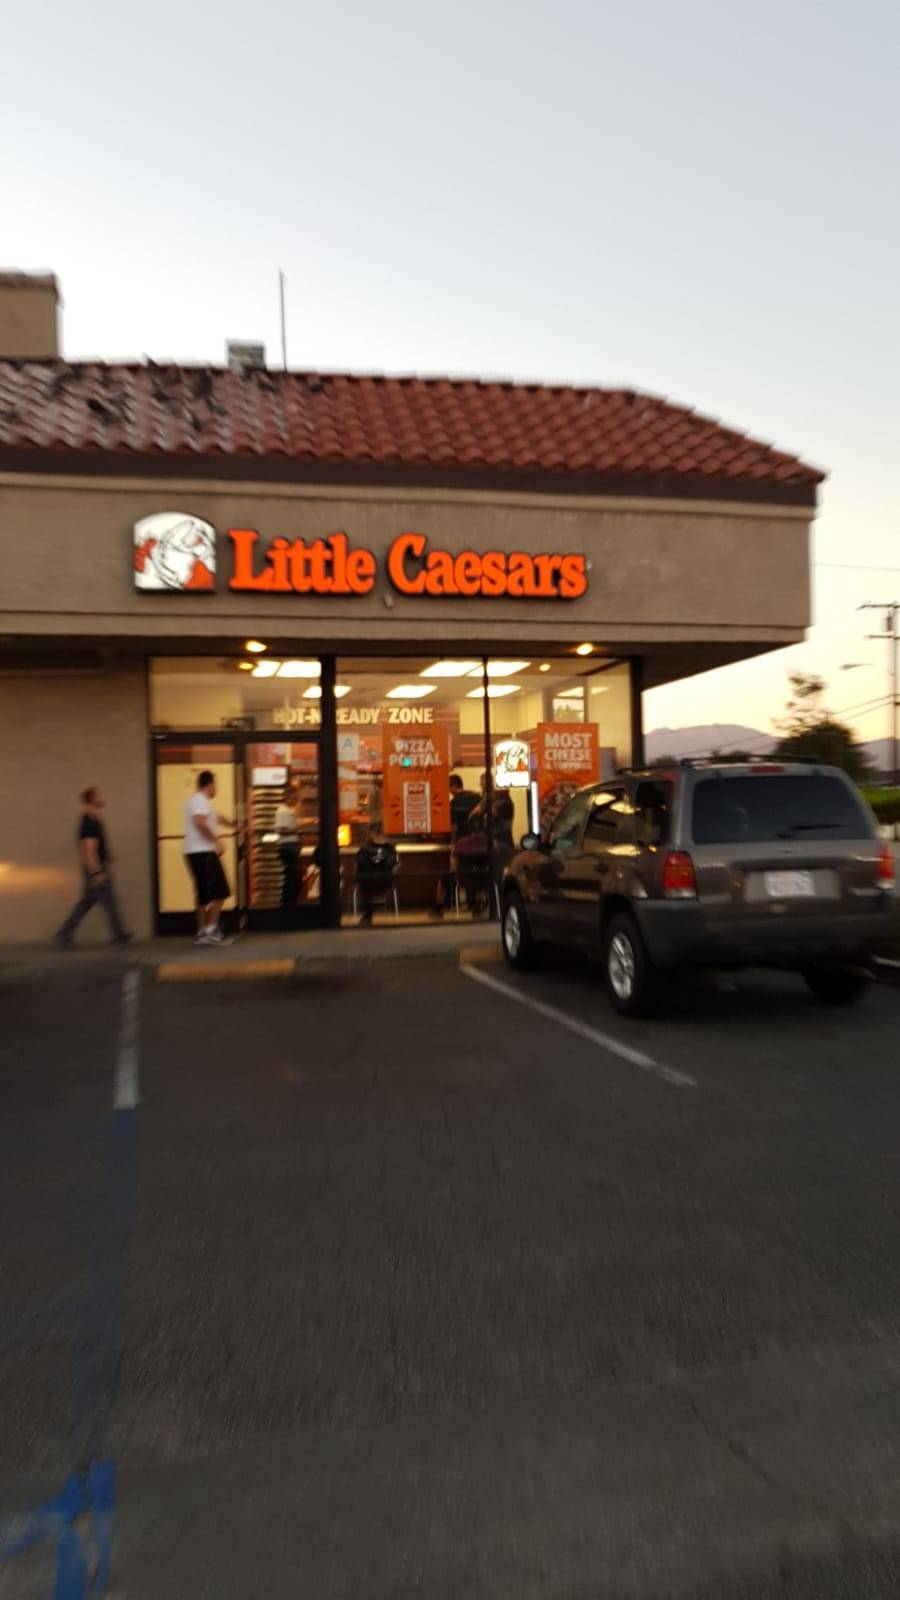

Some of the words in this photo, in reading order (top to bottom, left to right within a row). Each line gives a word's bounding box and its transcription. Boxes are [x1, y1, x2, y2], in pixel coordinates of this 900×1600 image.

[228, 528, 376, 594] Little
[388, 532, 589, 598] Caesars
[388, 707, 434, 724] ZONE
[342, 736, 353, 750] A
[394, 739, 435, 753] PIZZA
[543, 732, 593, 748] MOST
[543, 748, 593, 762] CHEESE
